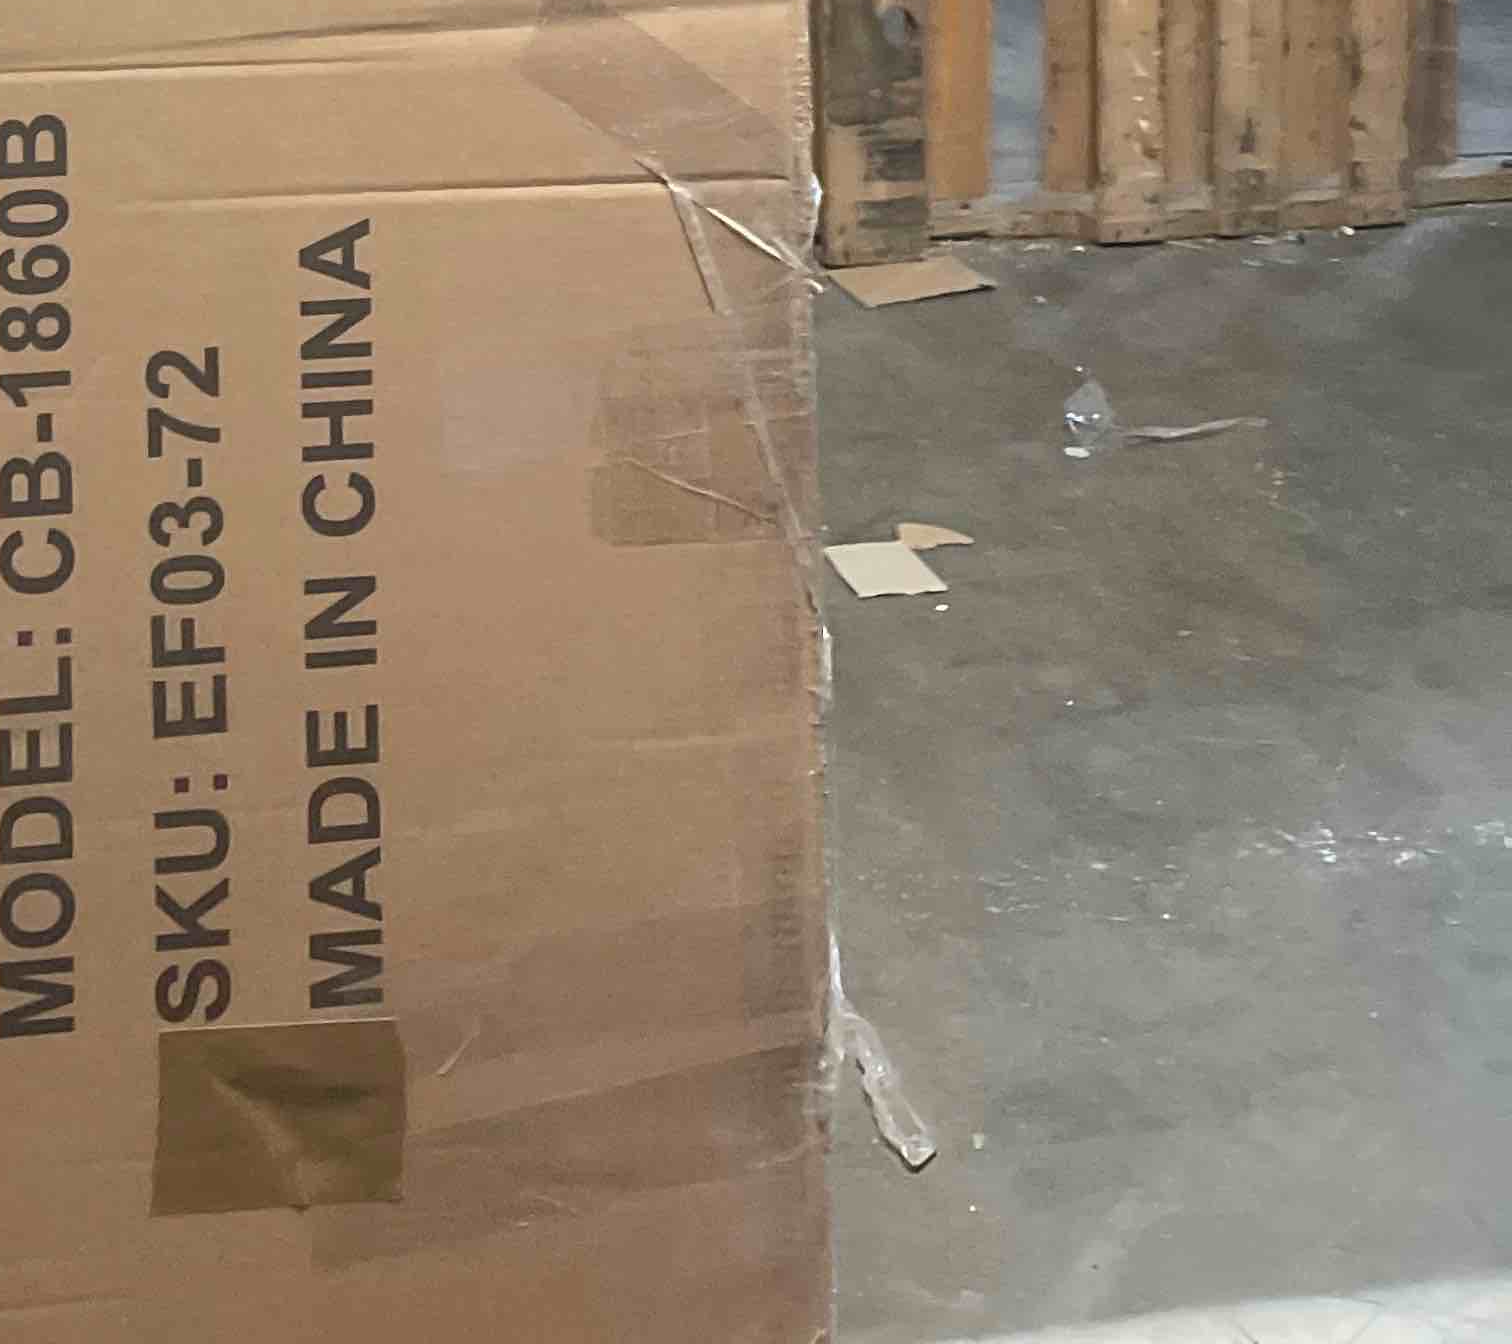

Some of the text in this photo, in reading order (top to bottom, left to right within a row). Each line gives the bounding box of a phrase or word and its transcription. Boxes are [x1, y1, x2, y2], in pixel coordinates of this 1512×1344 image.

[145, 345, 231, 1023] SKU: EF03-72
[298, 217, 384, 1010] MADE IN CHINA
